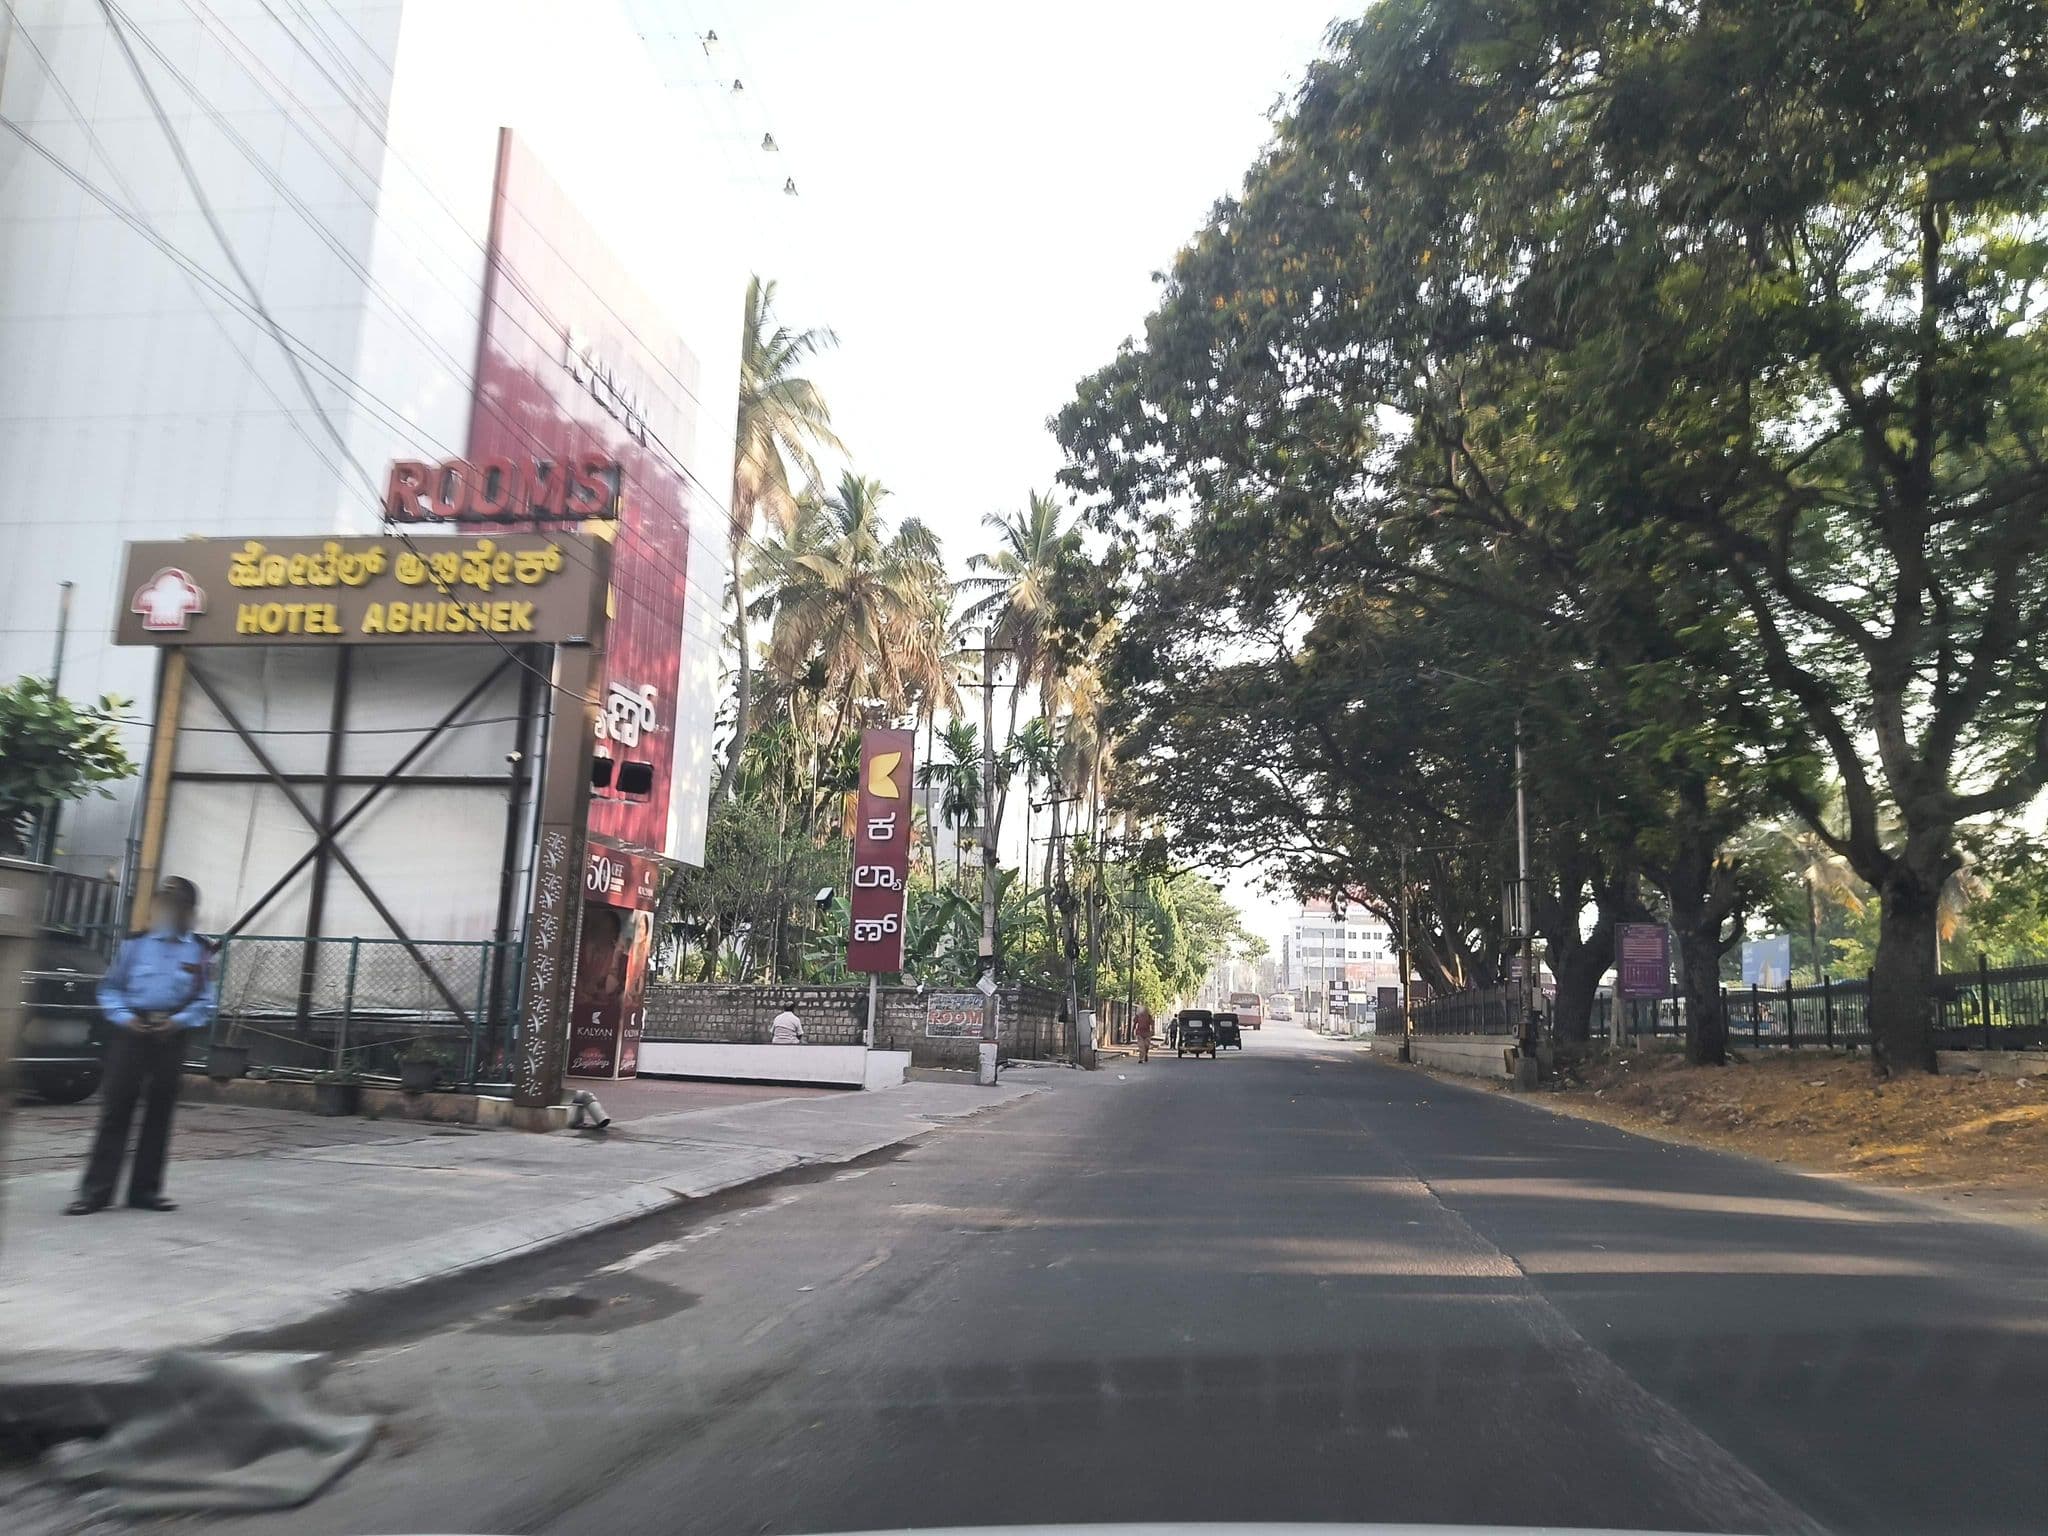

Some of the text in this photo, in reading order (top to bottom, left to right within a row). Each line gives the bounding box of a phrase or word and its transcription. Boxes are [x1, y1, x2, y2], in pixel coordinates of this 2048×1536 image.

[386, 454, 611, 518] ROOMS
[228, 539, 563, 592] ಹೋಟೆಲ್ ಅಭಿಷೇಕ್
[236, 602, 536, 634] HOTEL ABHISHEK
[577, 1027, 613, 1037] KALYAN
